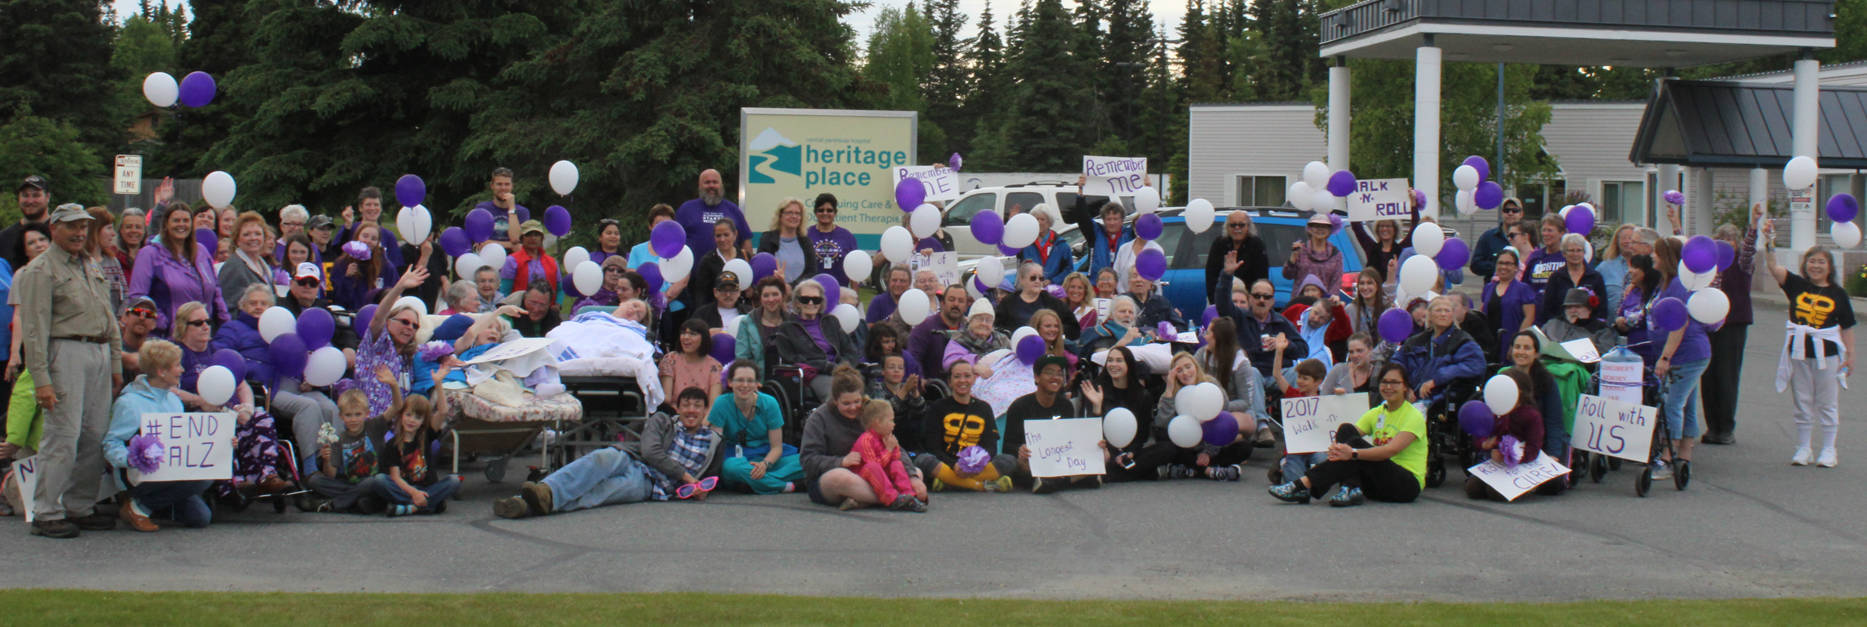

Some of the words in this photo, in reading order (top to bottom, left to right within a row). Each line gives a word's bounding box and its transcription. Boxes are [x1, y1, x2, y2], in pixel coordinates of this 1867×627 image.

[806, 144, 906, 169] heritage
[122, 169, 135, 177] ANY
[1086, 159, 1145, 176] Remember
[120, 181, 136, 189] TIME
[806, 167, 871, 189] place
[861, 199, 884, 209] Care
[885, 199, 892, 208] &
[1376, 201, 1412, 216] ROLL
[859, 213, 901, 224] Therapie
[1285, 397, 1319, 418] 2017
[1580, 396, 1606, 419] Roll
[1618, 407, 1645, 426] with
[146, 414, 218, 438] #END
[168, 441, 214, 468] ALZ
[1066, 456, 1087, 470] Day
